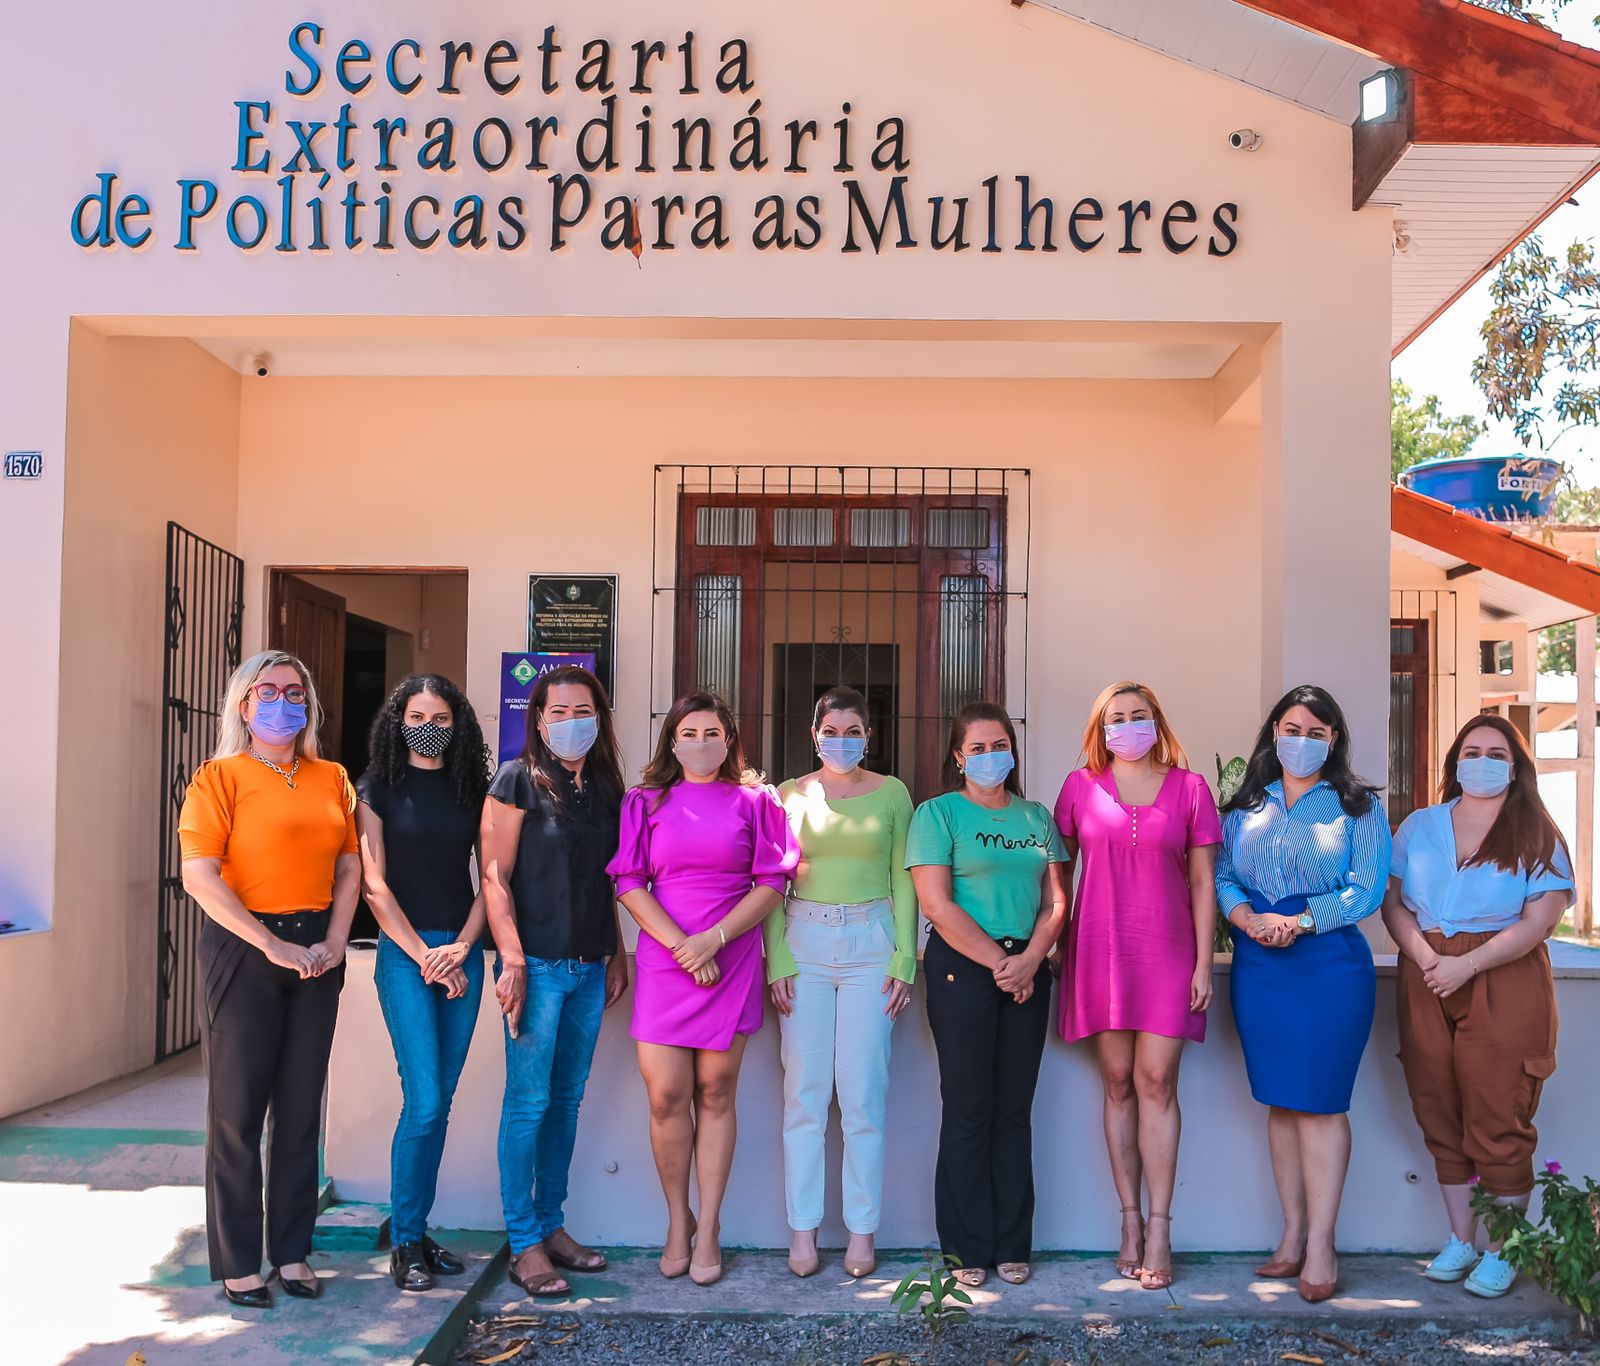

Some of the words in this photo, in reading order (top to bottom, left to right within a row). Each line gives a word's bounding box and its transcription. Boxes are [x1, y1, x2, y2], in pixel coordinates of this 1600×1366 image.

[285, 22, 755, 95] Secretaria
[230, 94, 911, 174] Extraordinária
[70, 172, 152, 249] de
[173, 173, 528, 252] Políticas
[547, 172, 730, 252] Para
[752, 195, 822, 252] as
[840, 174, 1238, 257] Mulheres
[7, 455, 40, 476] 1570
